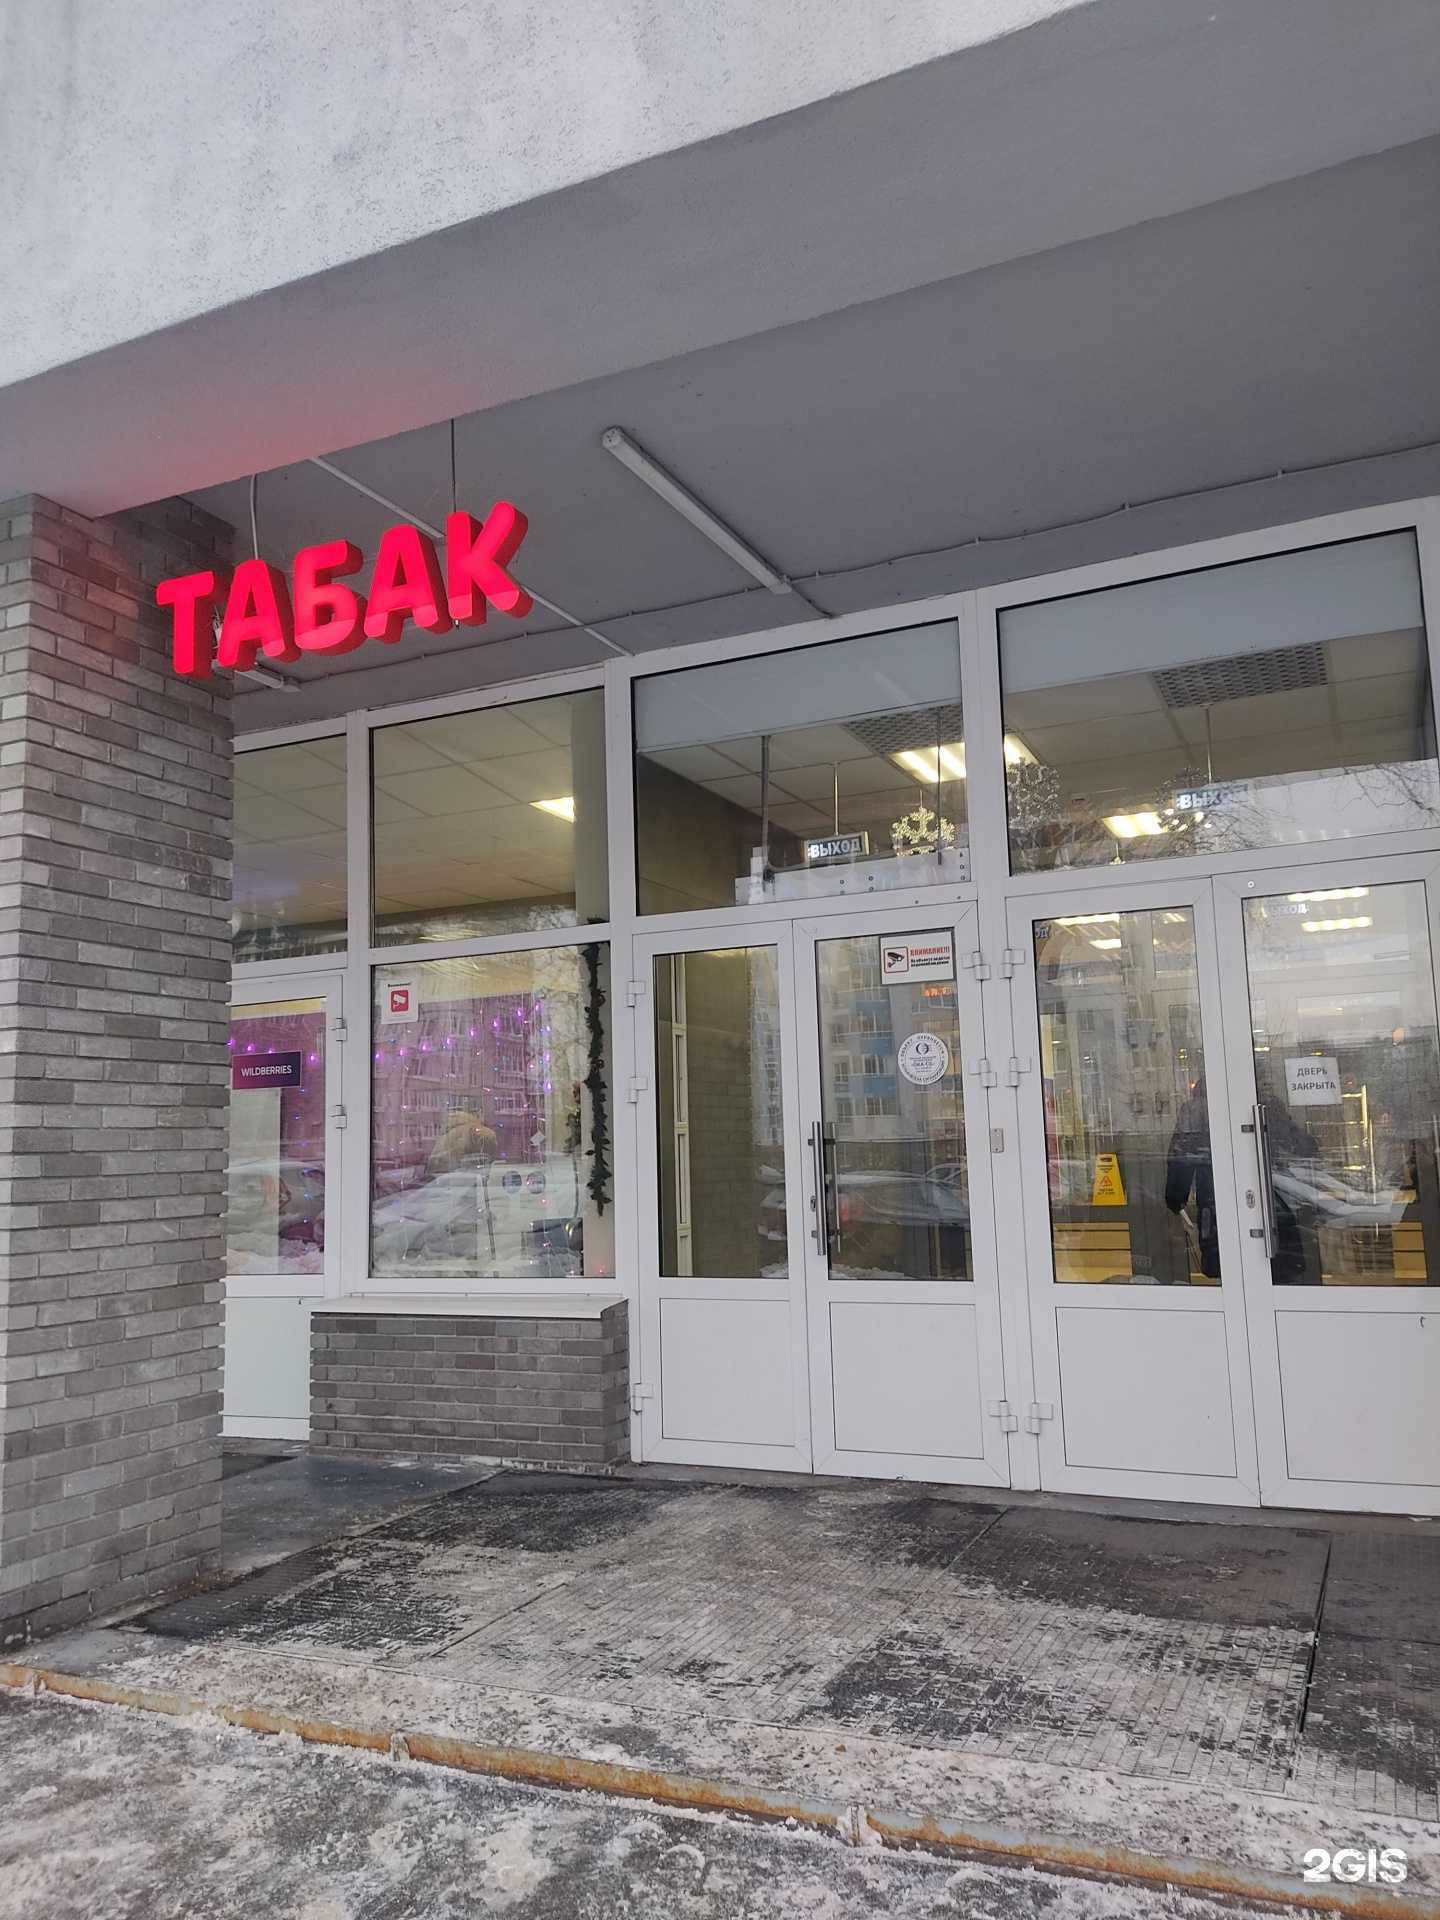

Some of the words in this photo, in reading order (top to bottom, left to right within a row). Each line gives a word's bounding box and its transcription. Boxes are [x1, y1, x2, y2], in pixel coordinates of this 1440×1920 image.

[155, 500, 533, 677] ТАБАК
[808, 838, 863, 858] ВЫХОД
[241, 1065, 292, 1077] WILDBERRIES
[1296, 1066, 1328, 1078] ДВЕРЬ
[1290, 1081, 1337, 1091] ЗАКРЫТА
